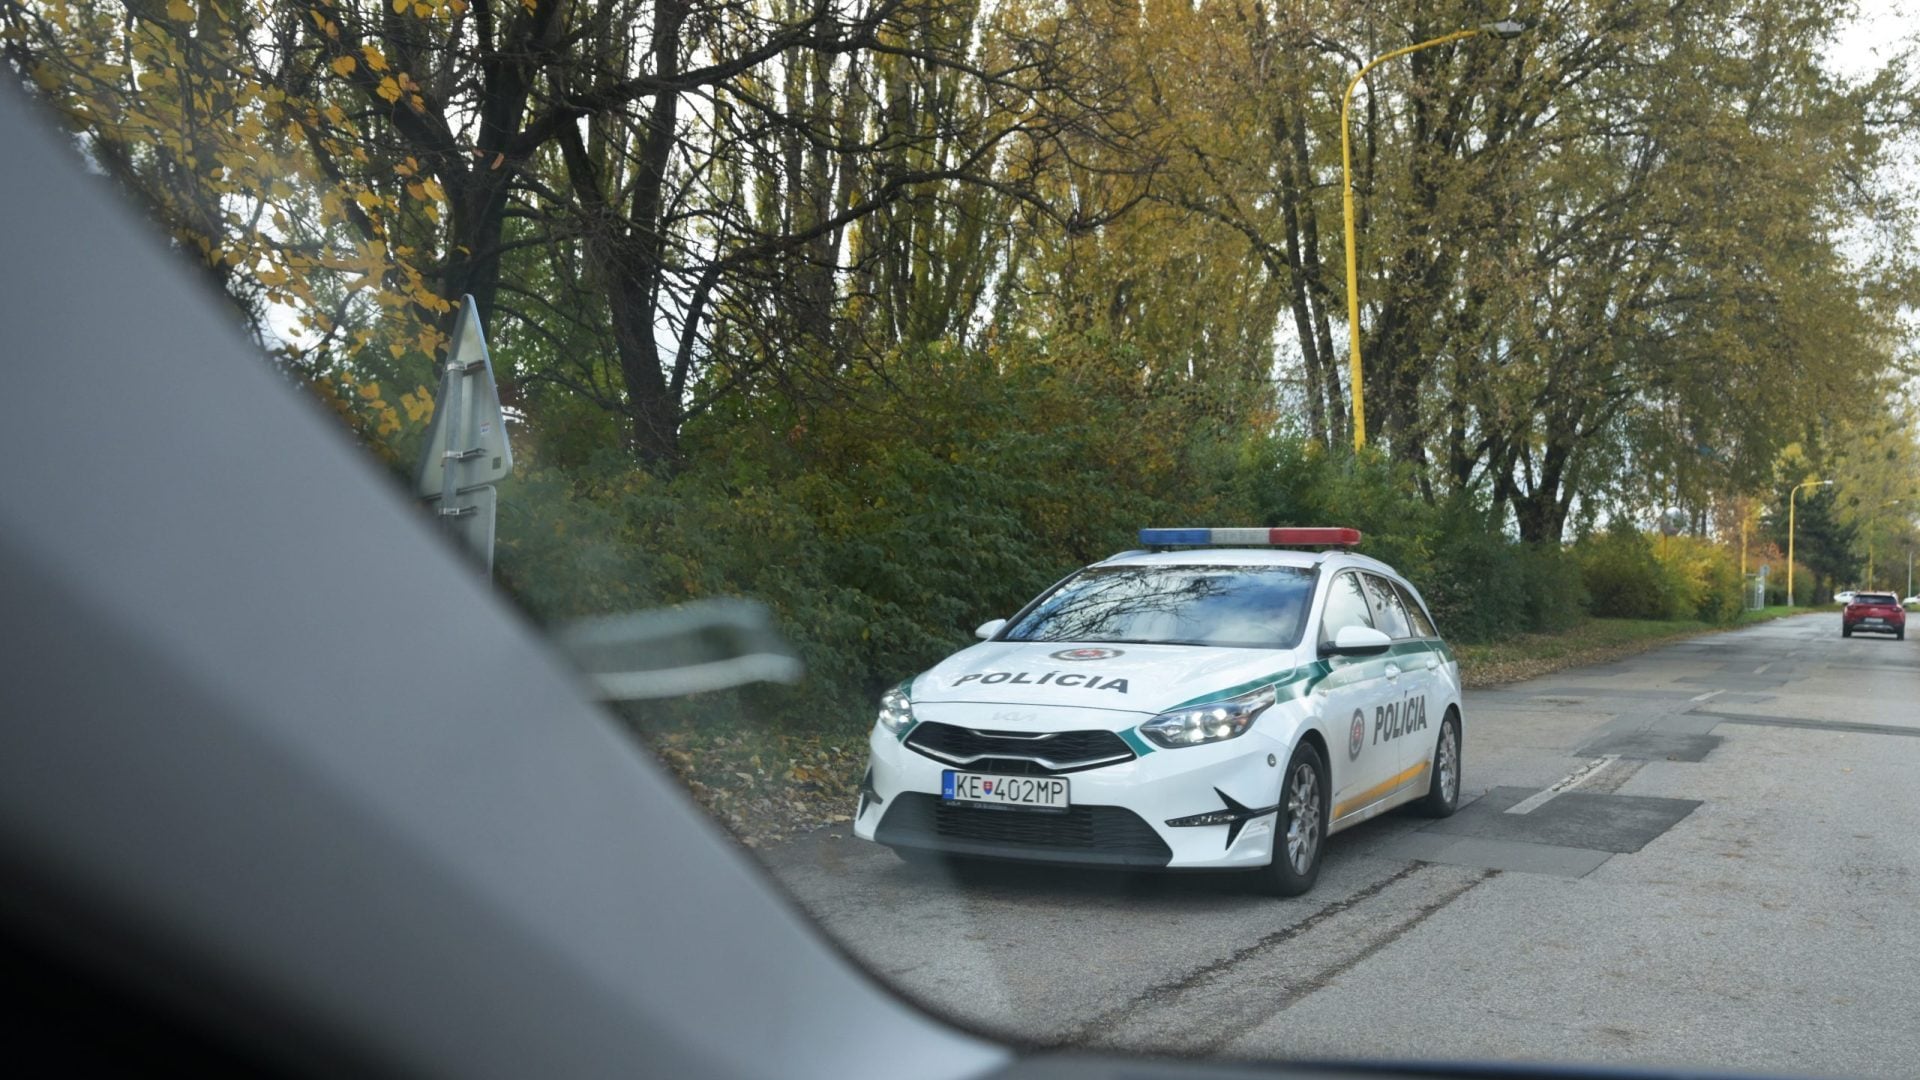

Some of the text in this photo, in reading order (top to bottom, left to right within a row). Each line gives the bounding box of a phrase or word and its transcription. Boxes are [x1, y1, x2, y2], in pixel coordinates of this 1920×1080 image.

[951, 670, 1129, 694] POLÍCIA
[1372, 690, 1427, 746] POLÍCIA
[956, 775, 1064, 804] KE 402MP
